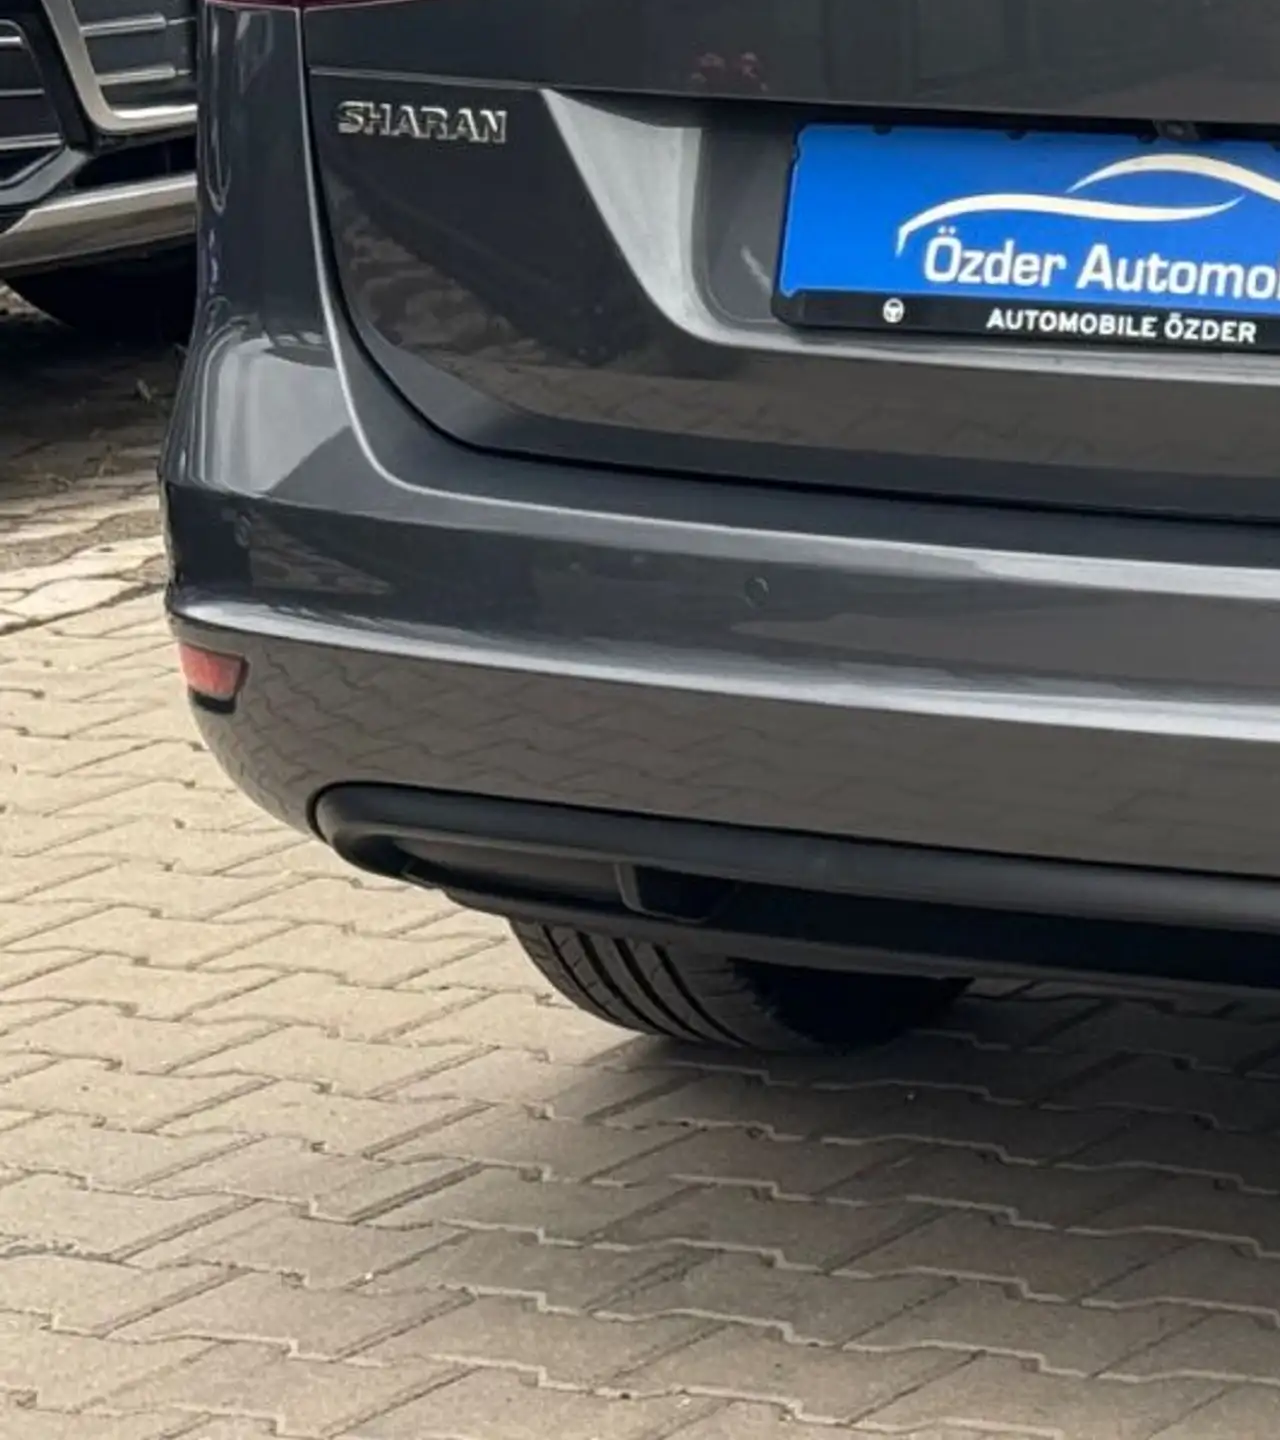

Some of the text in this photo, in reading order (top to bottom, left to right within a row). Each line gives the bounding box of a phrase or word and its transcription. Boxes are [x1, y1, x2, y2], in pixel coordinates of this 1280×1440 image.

[337, 101, 508, 144] SHARAN
[923, 225, 1067, 288] Özder
[986, 308, 1257, 343] AUTOMOBILE ÖZDER
